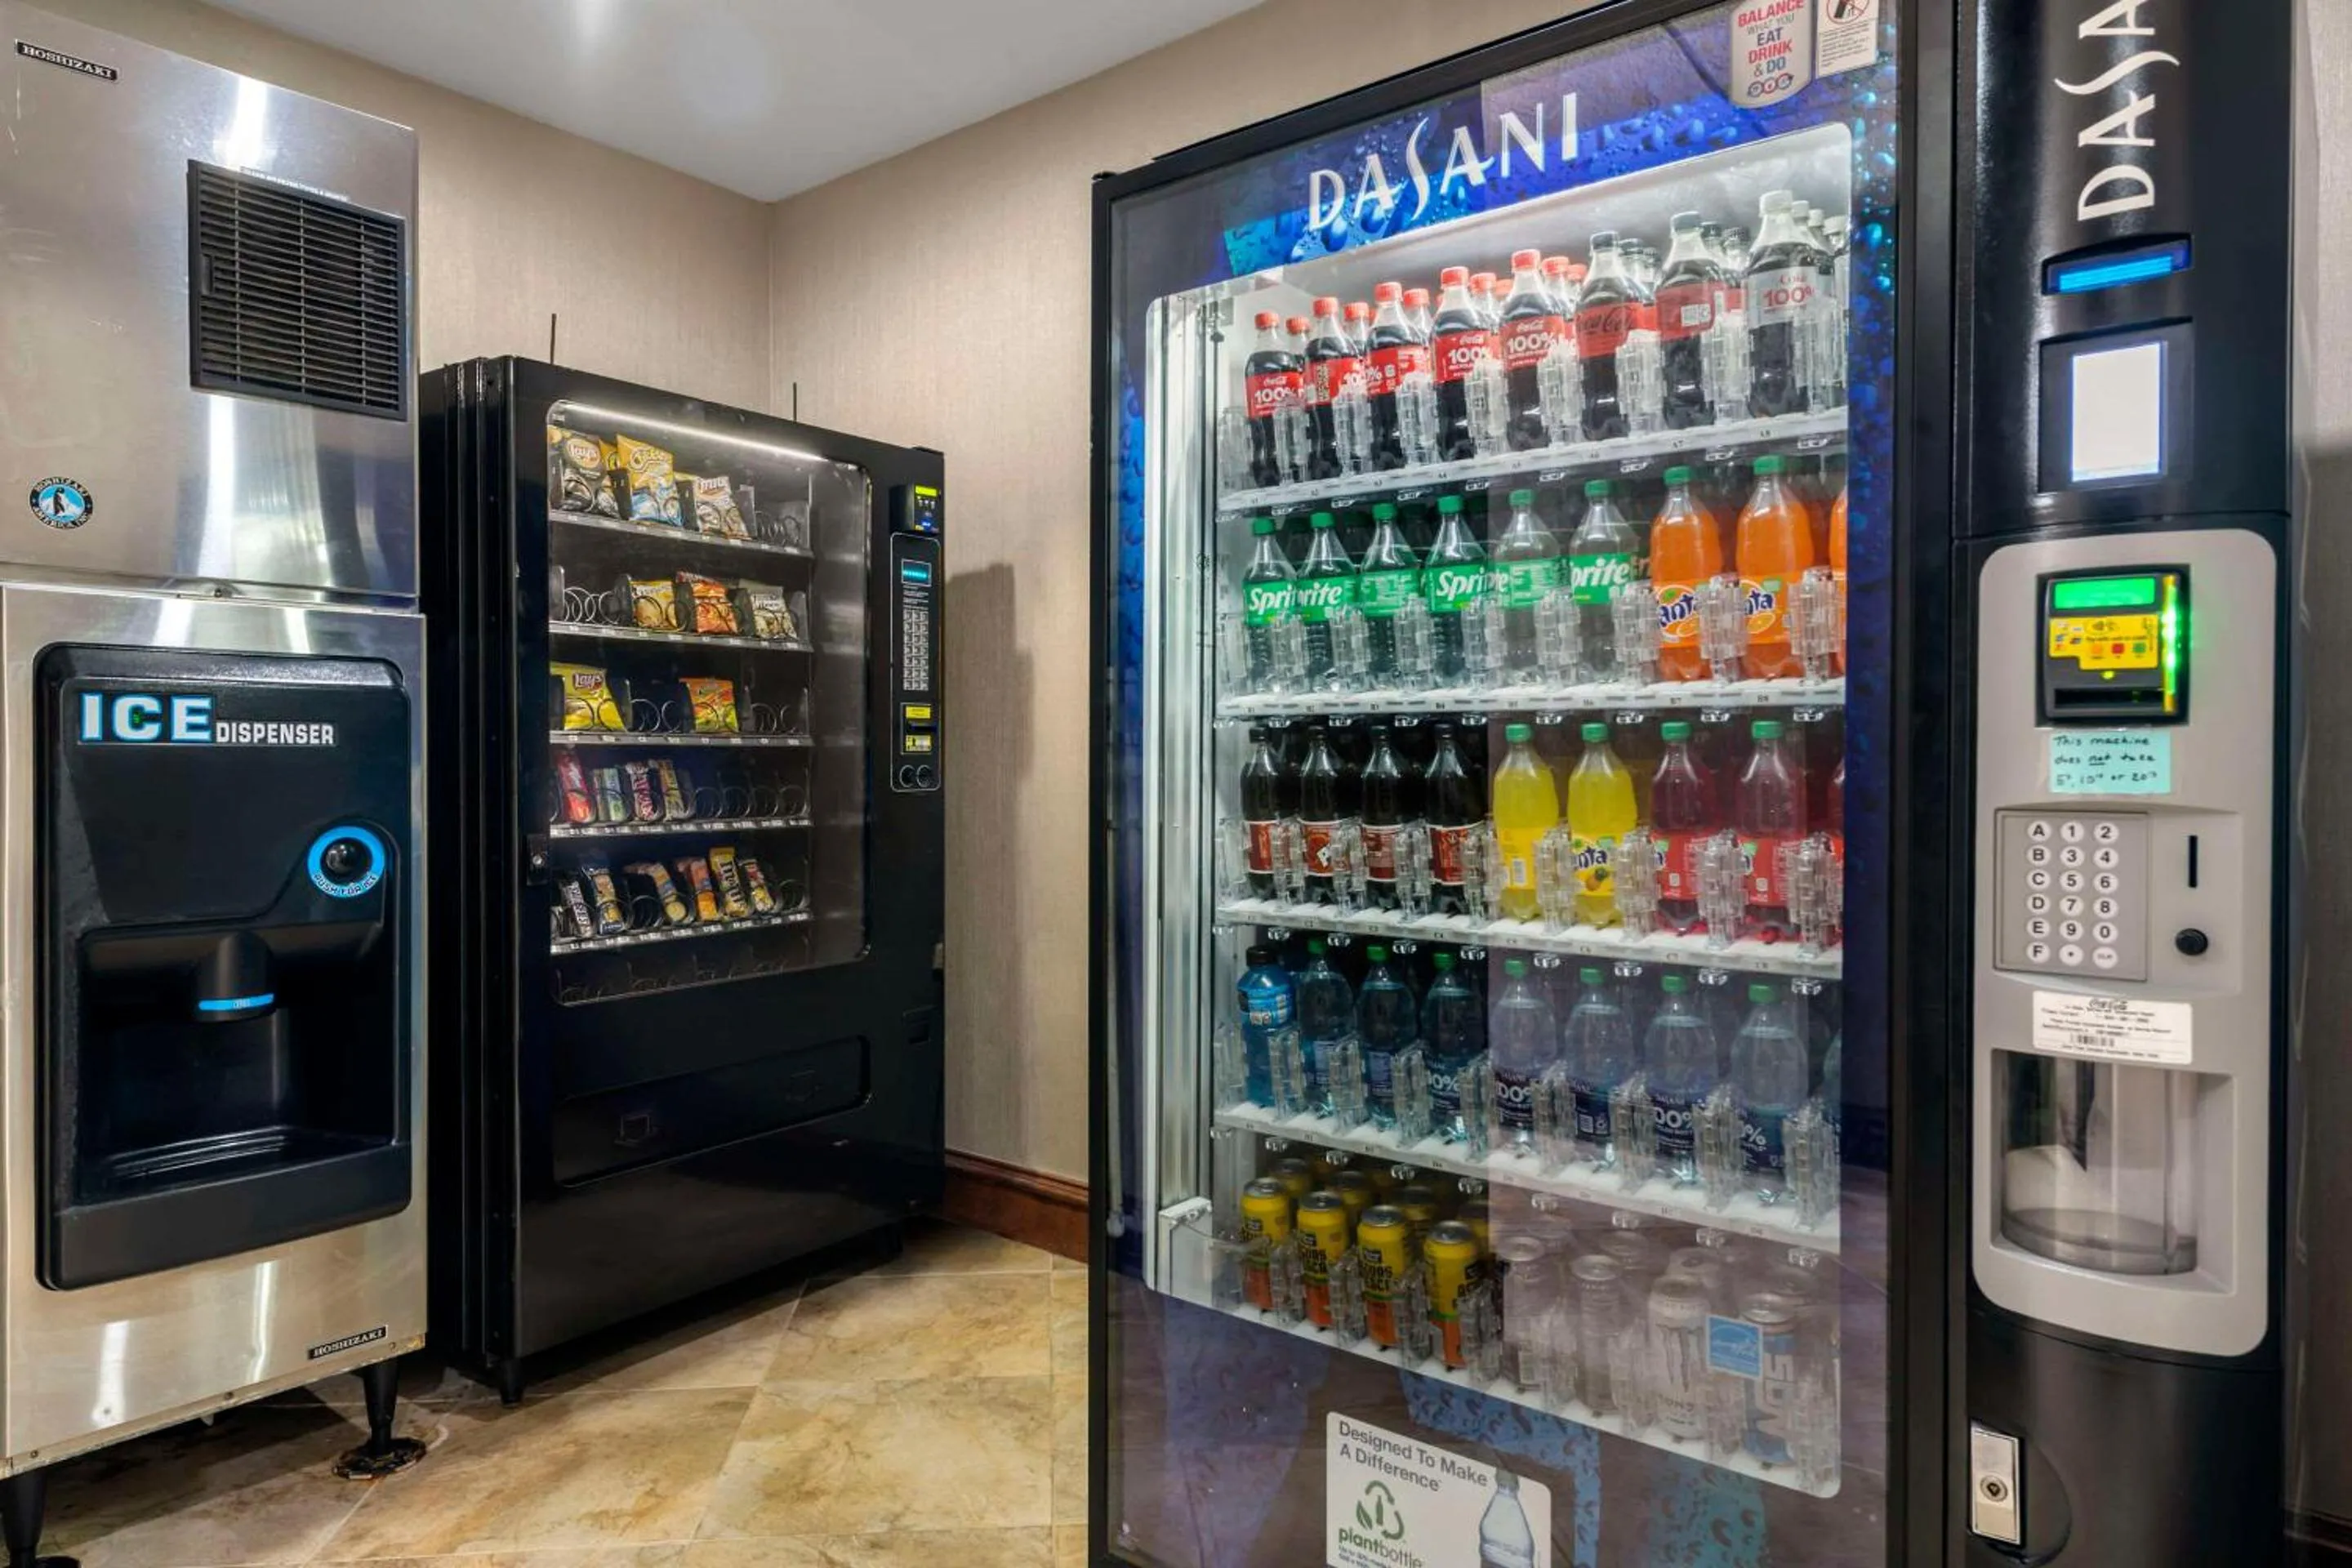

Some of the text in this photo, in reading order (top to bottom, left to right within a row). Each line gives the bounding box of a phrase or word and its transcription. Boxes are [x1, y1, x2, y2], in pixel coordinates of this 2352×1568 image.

[1738, 0, 1804, 27] BALANCE
[1775, 13, 1795, 26] YOU
[1757, 27, 1784, 47] EAT
[22, 45, 112, 78] HOSHIZAKI
[1748, 39, 1793, 65] DRINK
[1766, 56, 1786, 74] DO
[1308, 92, 1579, 230] DASANI
[1658, 594, 1699, 627] ant
[82, 693, 334, 745] ICE DISPENSER
[2053, 735, 2149, 746] This machine
[2088, 753, 2110, 765] not
[2033, 825, 2045, 836] A
[2100, 826, 2110, 839] 2
[2034, 849, 2110, 863] B 3 4
[314, 874, 376, 894] PUSH FOR ICE
[2033, 873, 2110, 889] C 5 6
[2033, 897, 2110, 913] D 7 8
[2034, 921, 2110, 938] E 9 0
[2034, 946, 2042, 958] F
[314, 1330, 383, 1356] HOSHIZAKI
[1339, 1420, 1488, 1487] Designed To Make
[1339, 1444, 1440, 1492] A Difference
[1339, 1528, 1423, 1568] plantbottle
